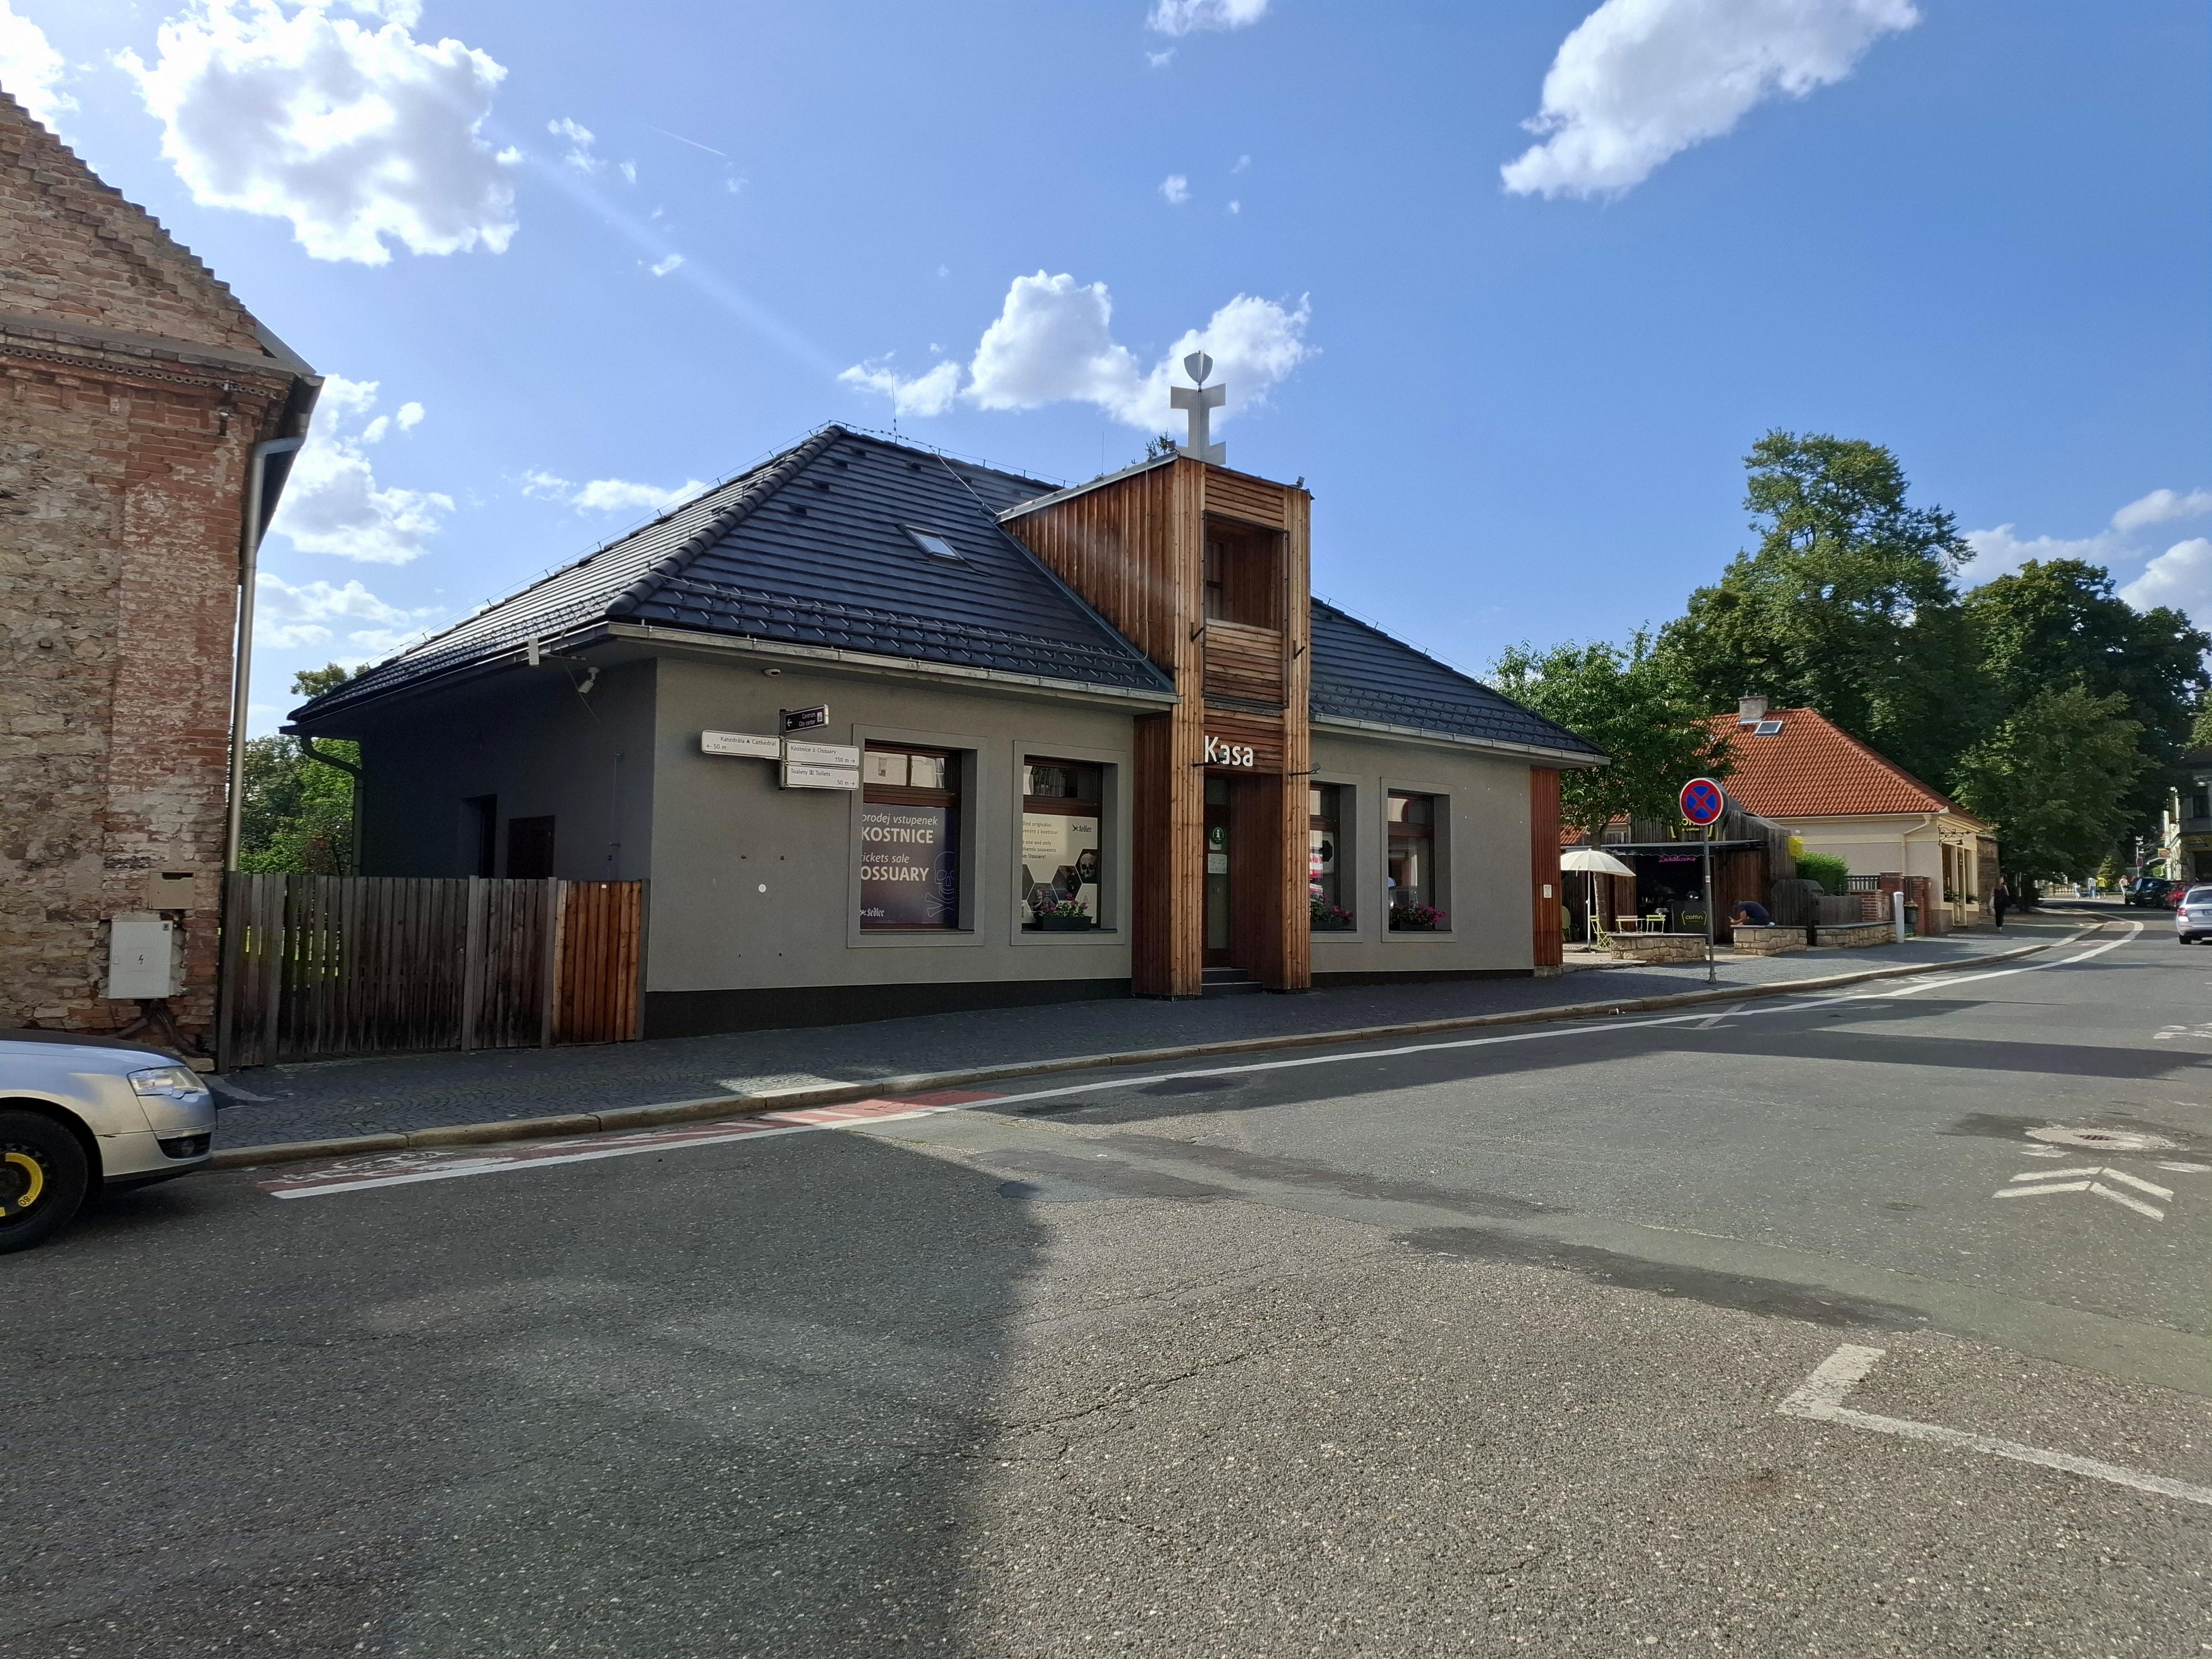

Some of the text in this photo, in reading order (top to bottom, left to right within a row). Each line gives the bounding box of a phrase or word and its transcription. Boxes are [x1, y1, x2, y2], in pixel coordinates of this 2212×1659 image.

[1204, 735, 1253, 766] Kasa
[894, 816, 938, 826] vstupenek
[862, 827, 934, 844] KOSTNICE
[891, 854, 910, 863] sale
[861, 866, 930, 881] OSSUARY
